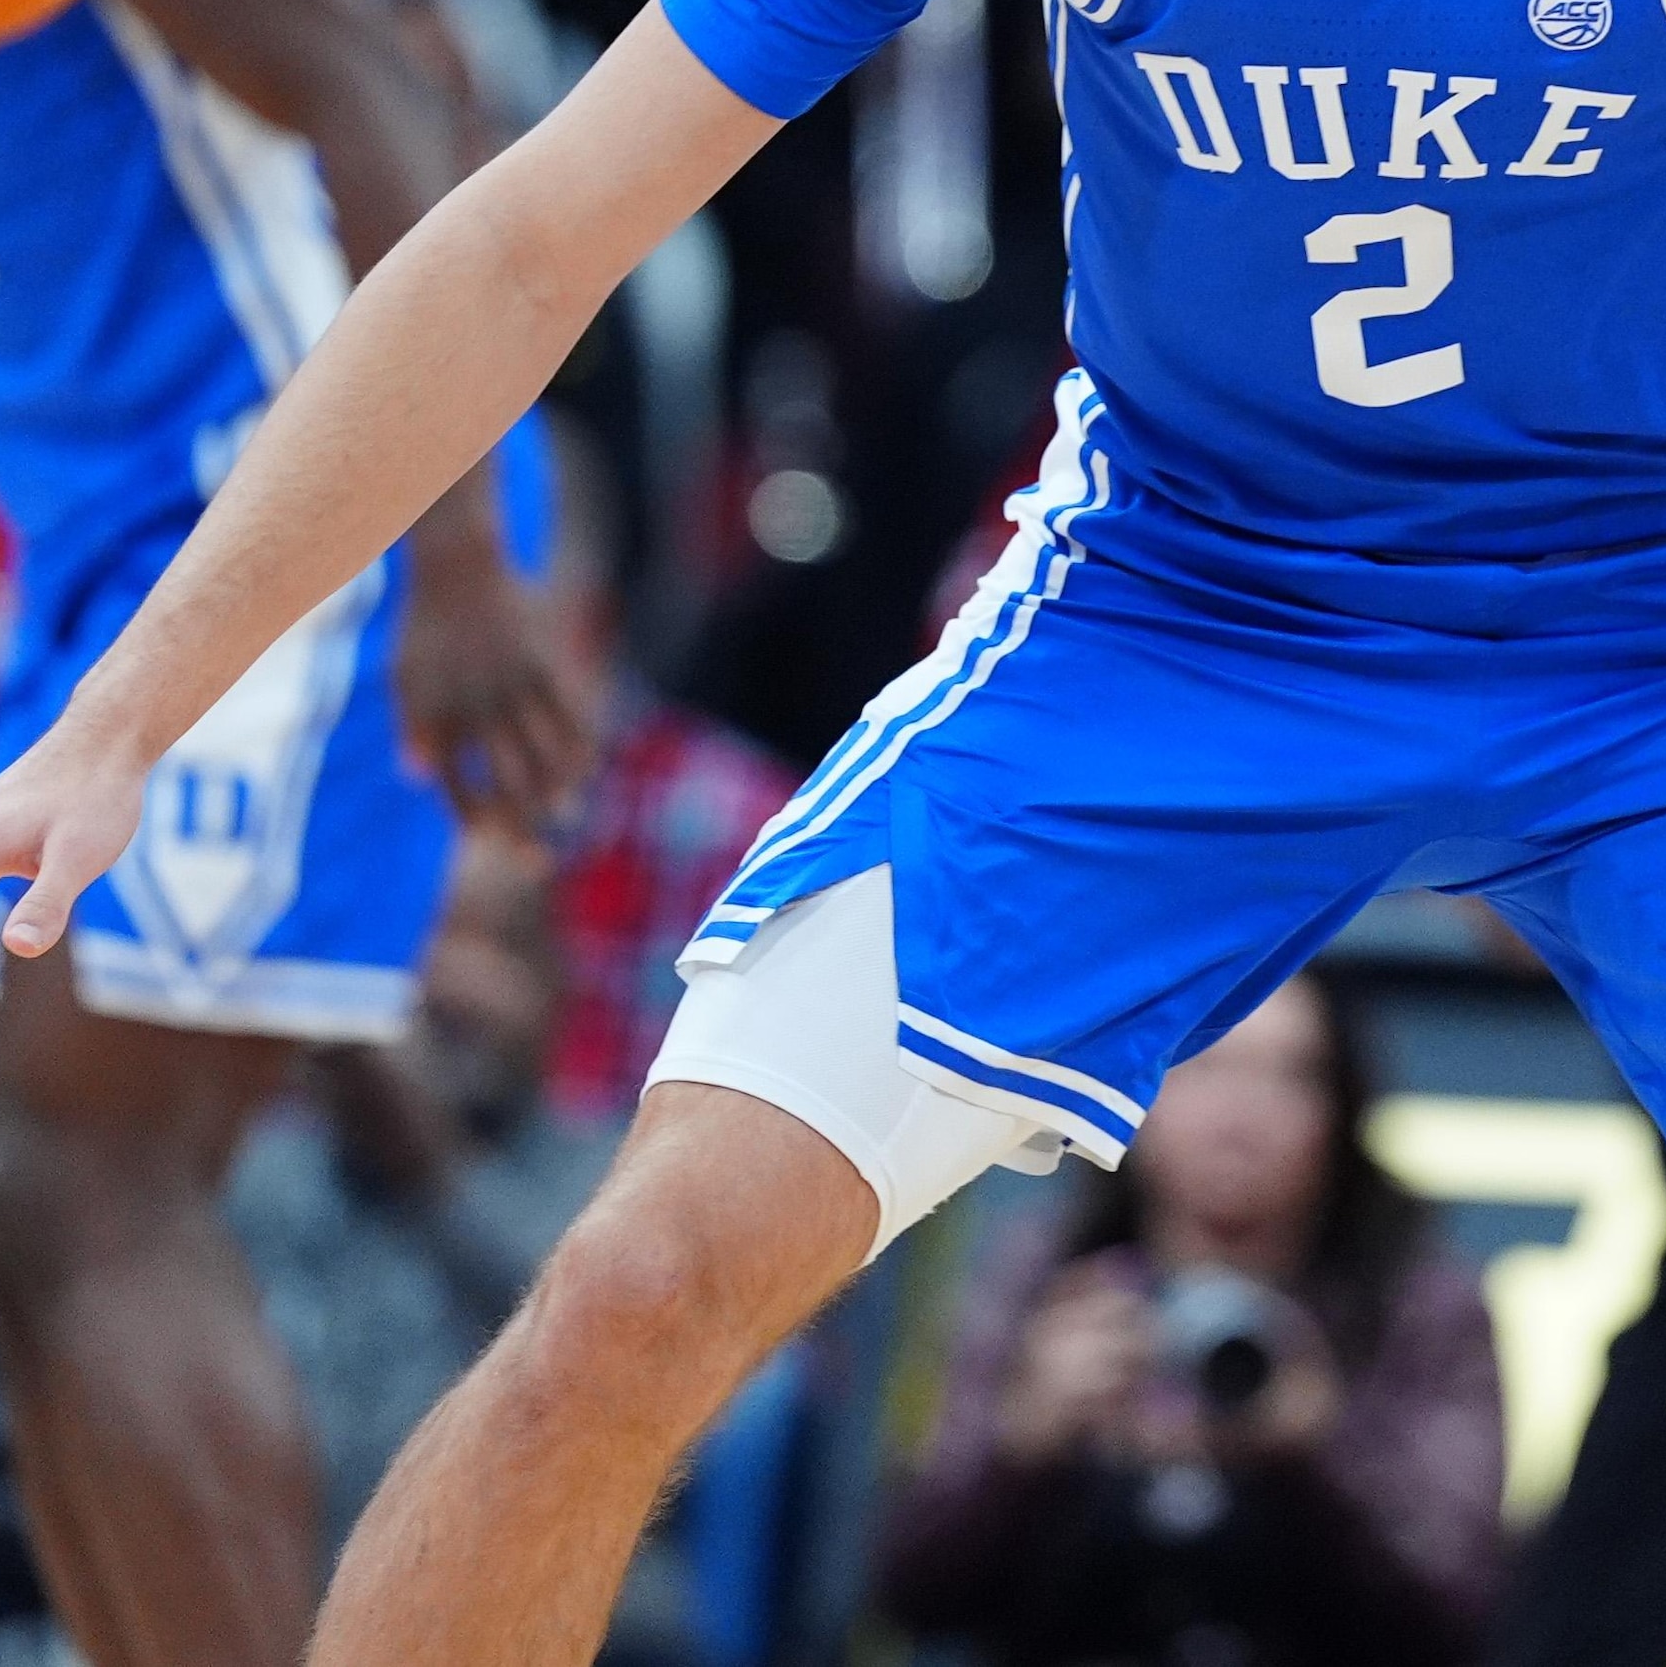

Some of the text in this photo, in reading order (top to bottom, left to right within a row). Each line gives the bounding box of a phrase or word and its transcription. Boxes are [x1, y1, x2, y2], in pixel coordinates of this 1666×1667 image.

[1542, 1, 1606, 17] ACC
[1133, 51, 1637, 181] DUKE
[1303, 203, 1466, 409] 2
